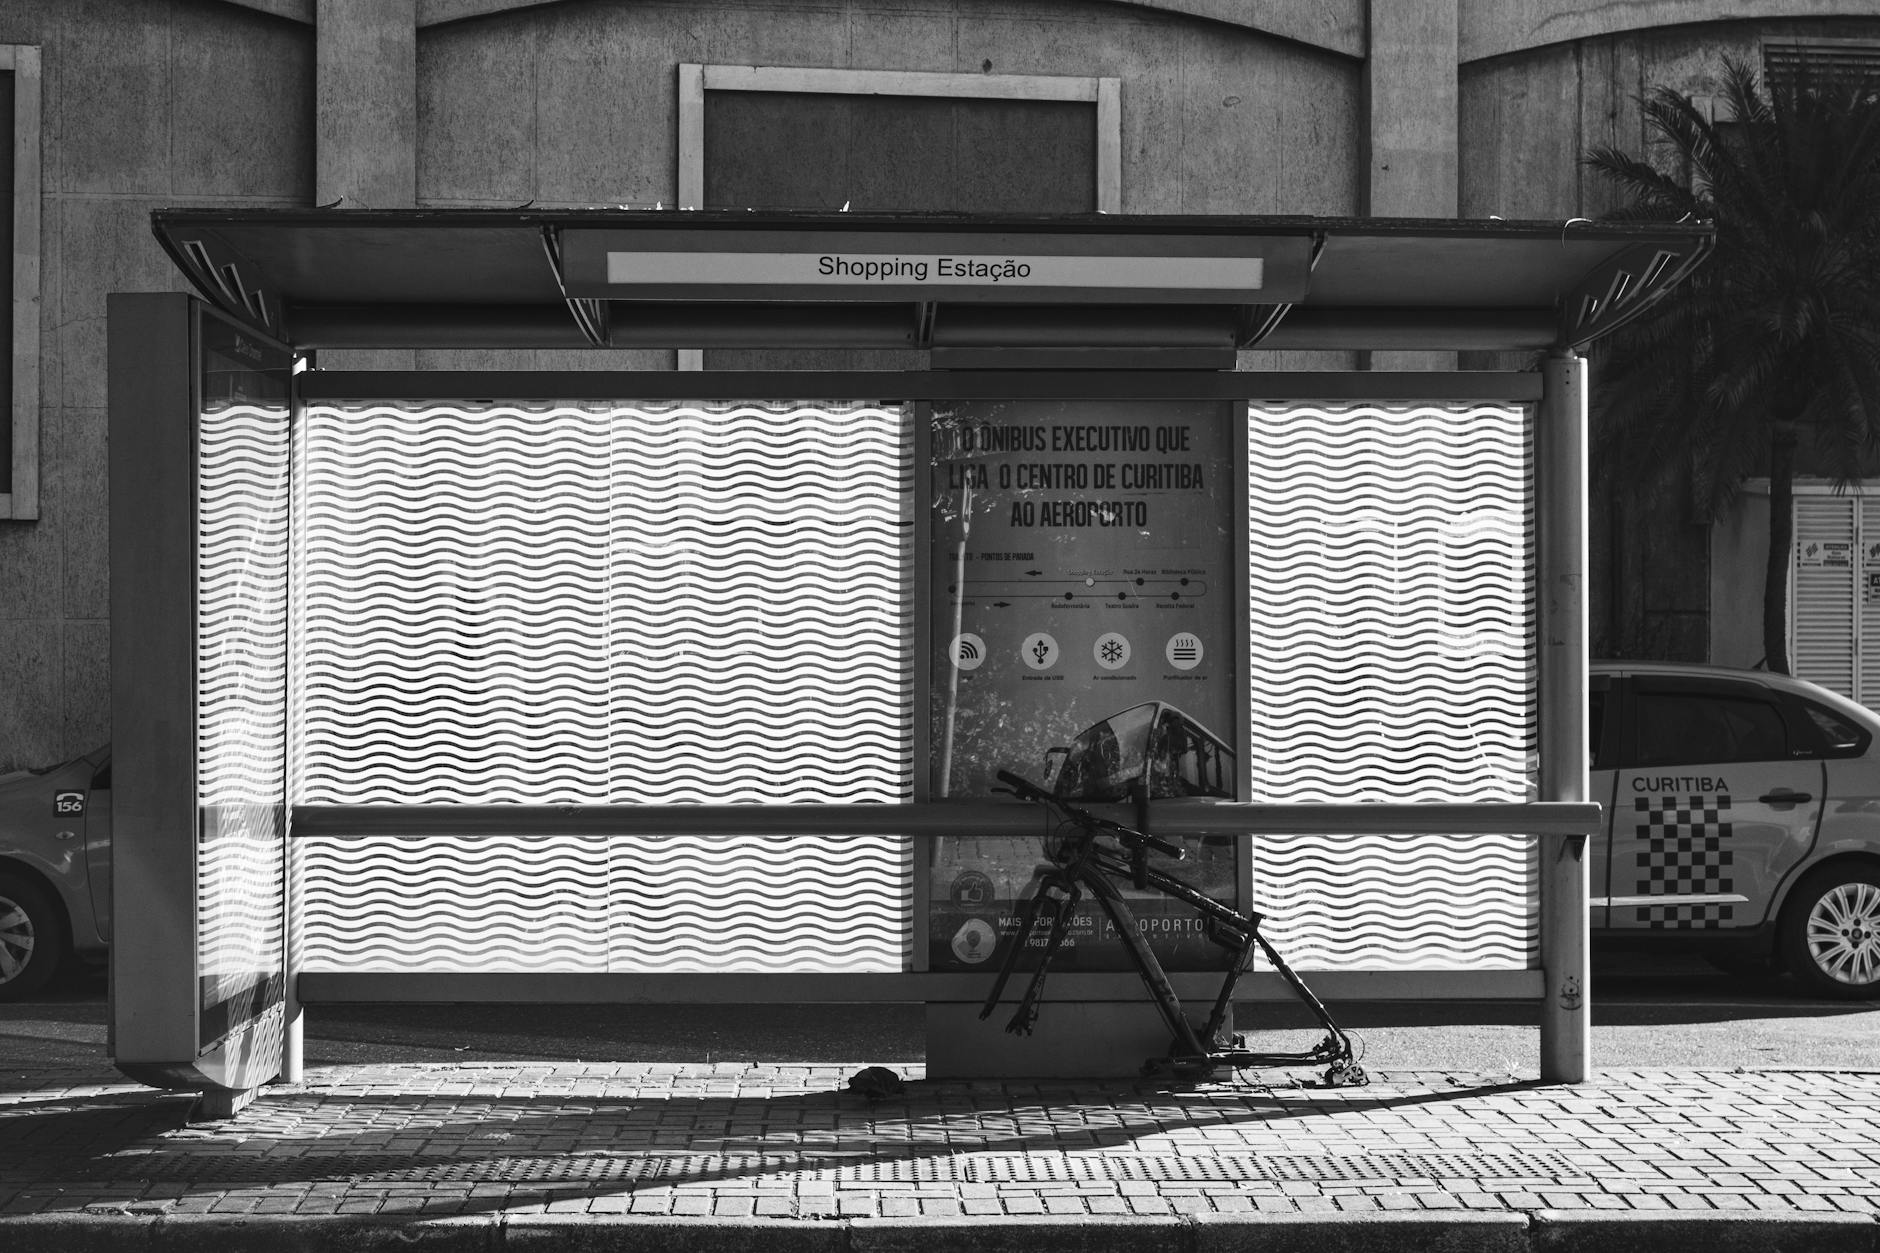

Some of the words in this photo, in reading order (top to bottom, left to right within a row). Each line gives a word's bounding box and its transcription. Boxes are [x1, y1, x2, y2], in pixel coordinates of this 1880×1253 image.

[819, 256, 928, 281] Shopping
[938, 258, 1031, 282] Estação
[981, 420, 1046, 450] ÔNIBUS
[1052, 426, 1150, 451] EXECUTIVO
[1156, 426, 1190, 454] QUE
[950, 463, 988, 489] LIGA
[1000, 463, 1010, 489] O
[1017, 463, 1087, 489] CENTRO
[1094, 463, 1116, 489] DE
[1122, 463, 1204, 489] CURITIBA
[1011, 502, 1035, 527] AO
[1040, 501, 1147, 527] AEROPORTO
[1632, 777, 1729, 792] CURITIBA
[57, 801, 82, 812] 156
[999, 917, 1022, 927] MAIS
[1106, 918, 1204, 932] AOPORTO
